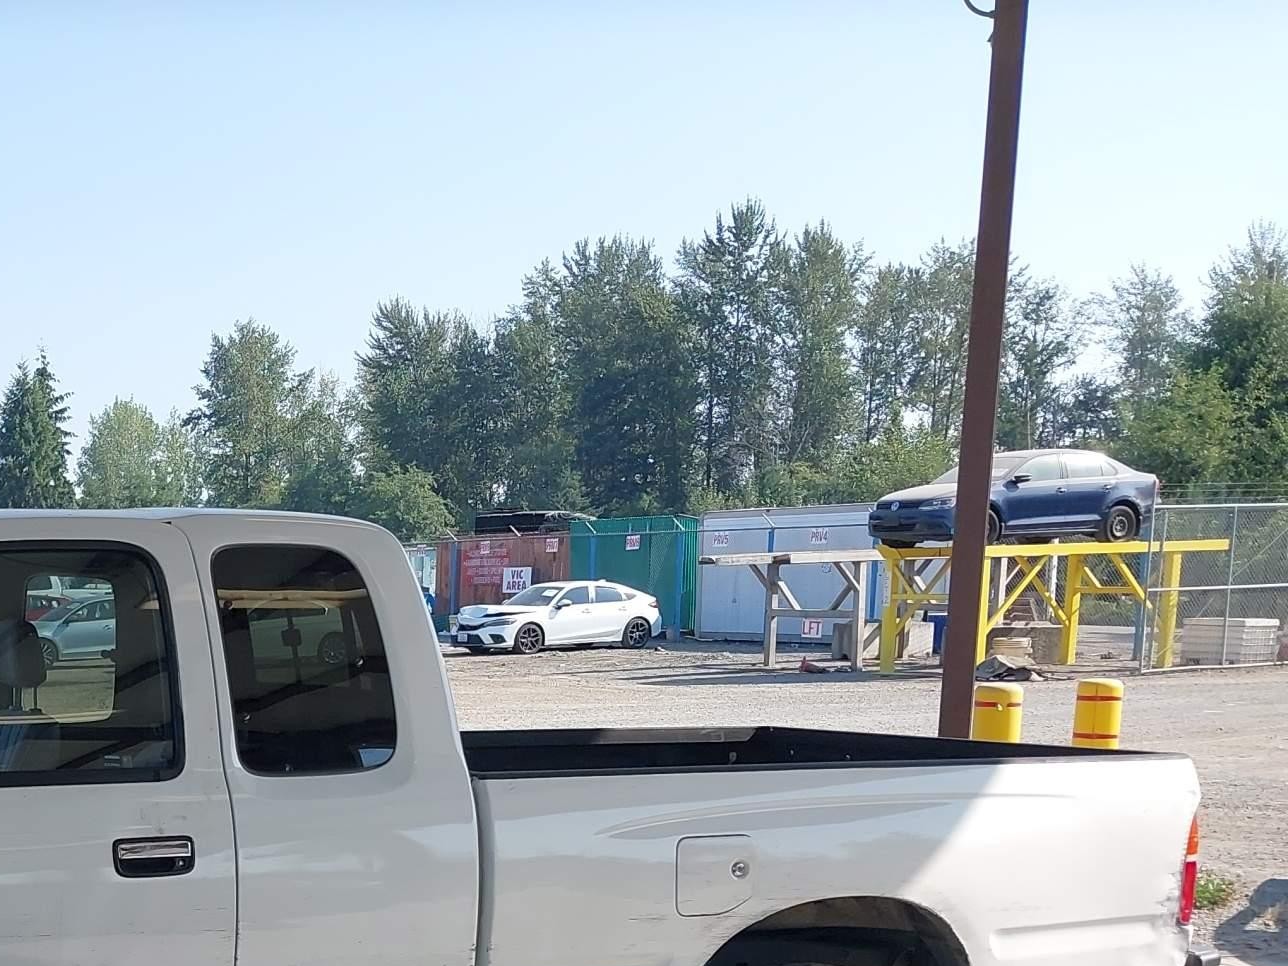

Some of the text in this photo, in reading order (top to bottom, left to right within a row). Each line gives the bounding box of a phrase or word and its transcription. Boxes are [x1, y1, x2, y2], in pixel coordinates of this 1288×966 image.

[713, 533, 729, 545] PRV5
[810, 529, 828, 542] PRV4
[511, 569, 524, 580] VIC
[505, 580, 528, 591] AREA
[802, 621, 822, 635] LFT
